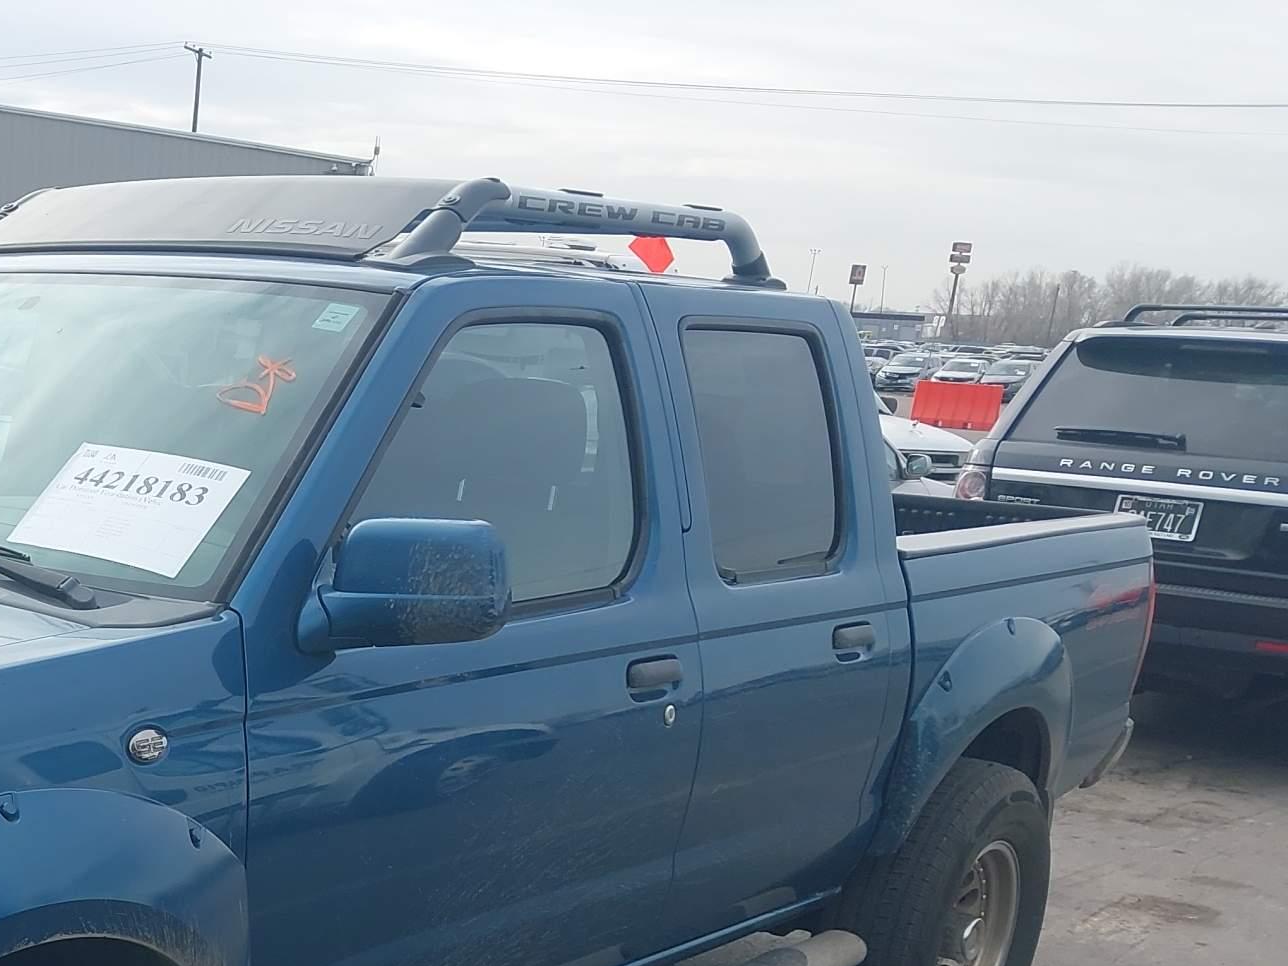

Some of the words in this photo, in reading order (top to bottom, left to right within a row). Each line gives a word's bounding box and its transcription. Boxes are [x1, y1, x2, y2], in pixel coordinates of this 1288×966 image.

[226, 217, 384, 239] NISSAN
[517, 195, 638, 221] CREW
[651, 210, 726, 232] CAB
[73, 466, 210, 506] 44218183
[1059, 458, 1156, 474] RANGE
[1176, 468, 1281, 486] ROVER
